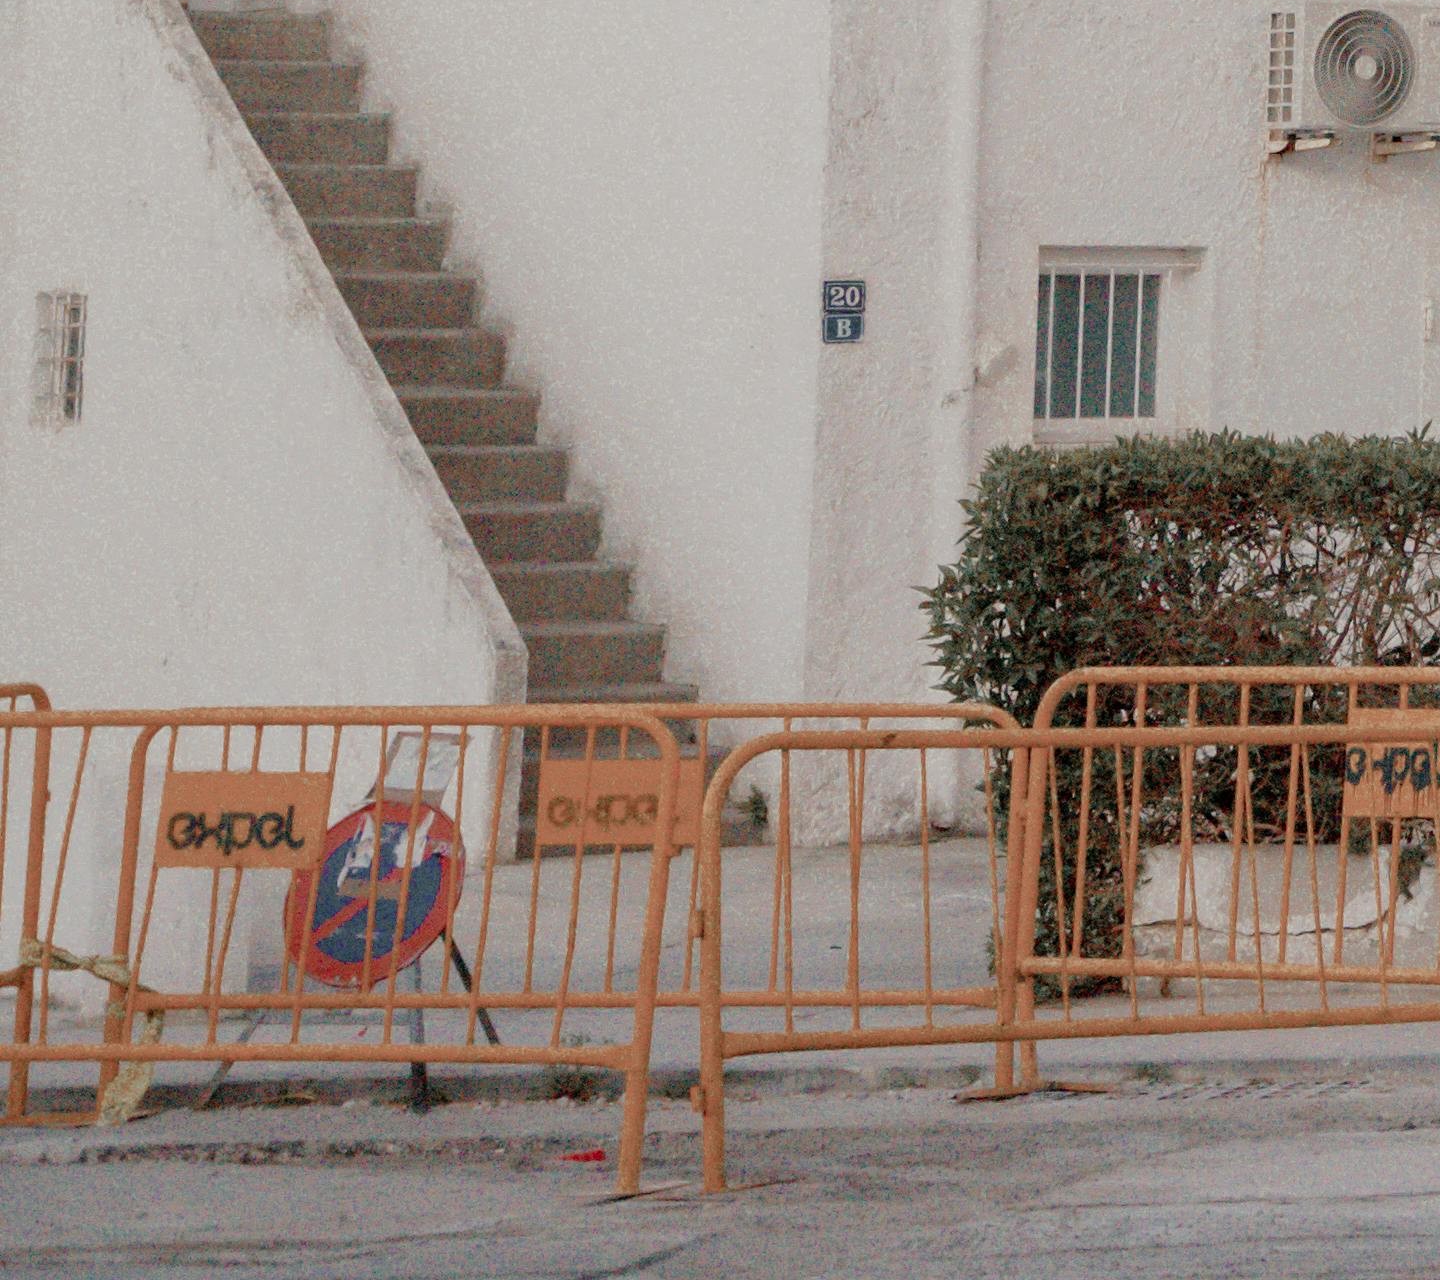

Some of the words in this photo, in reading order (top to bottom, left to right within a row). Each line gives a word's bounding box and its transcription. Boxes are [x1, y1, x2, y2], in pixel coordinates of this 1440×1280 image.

[830, 286, 860, 307] 20
[836, 318, 852, 338] B
[547, 793, 680, 832] expe
[167, 805, 305, 856] expel
